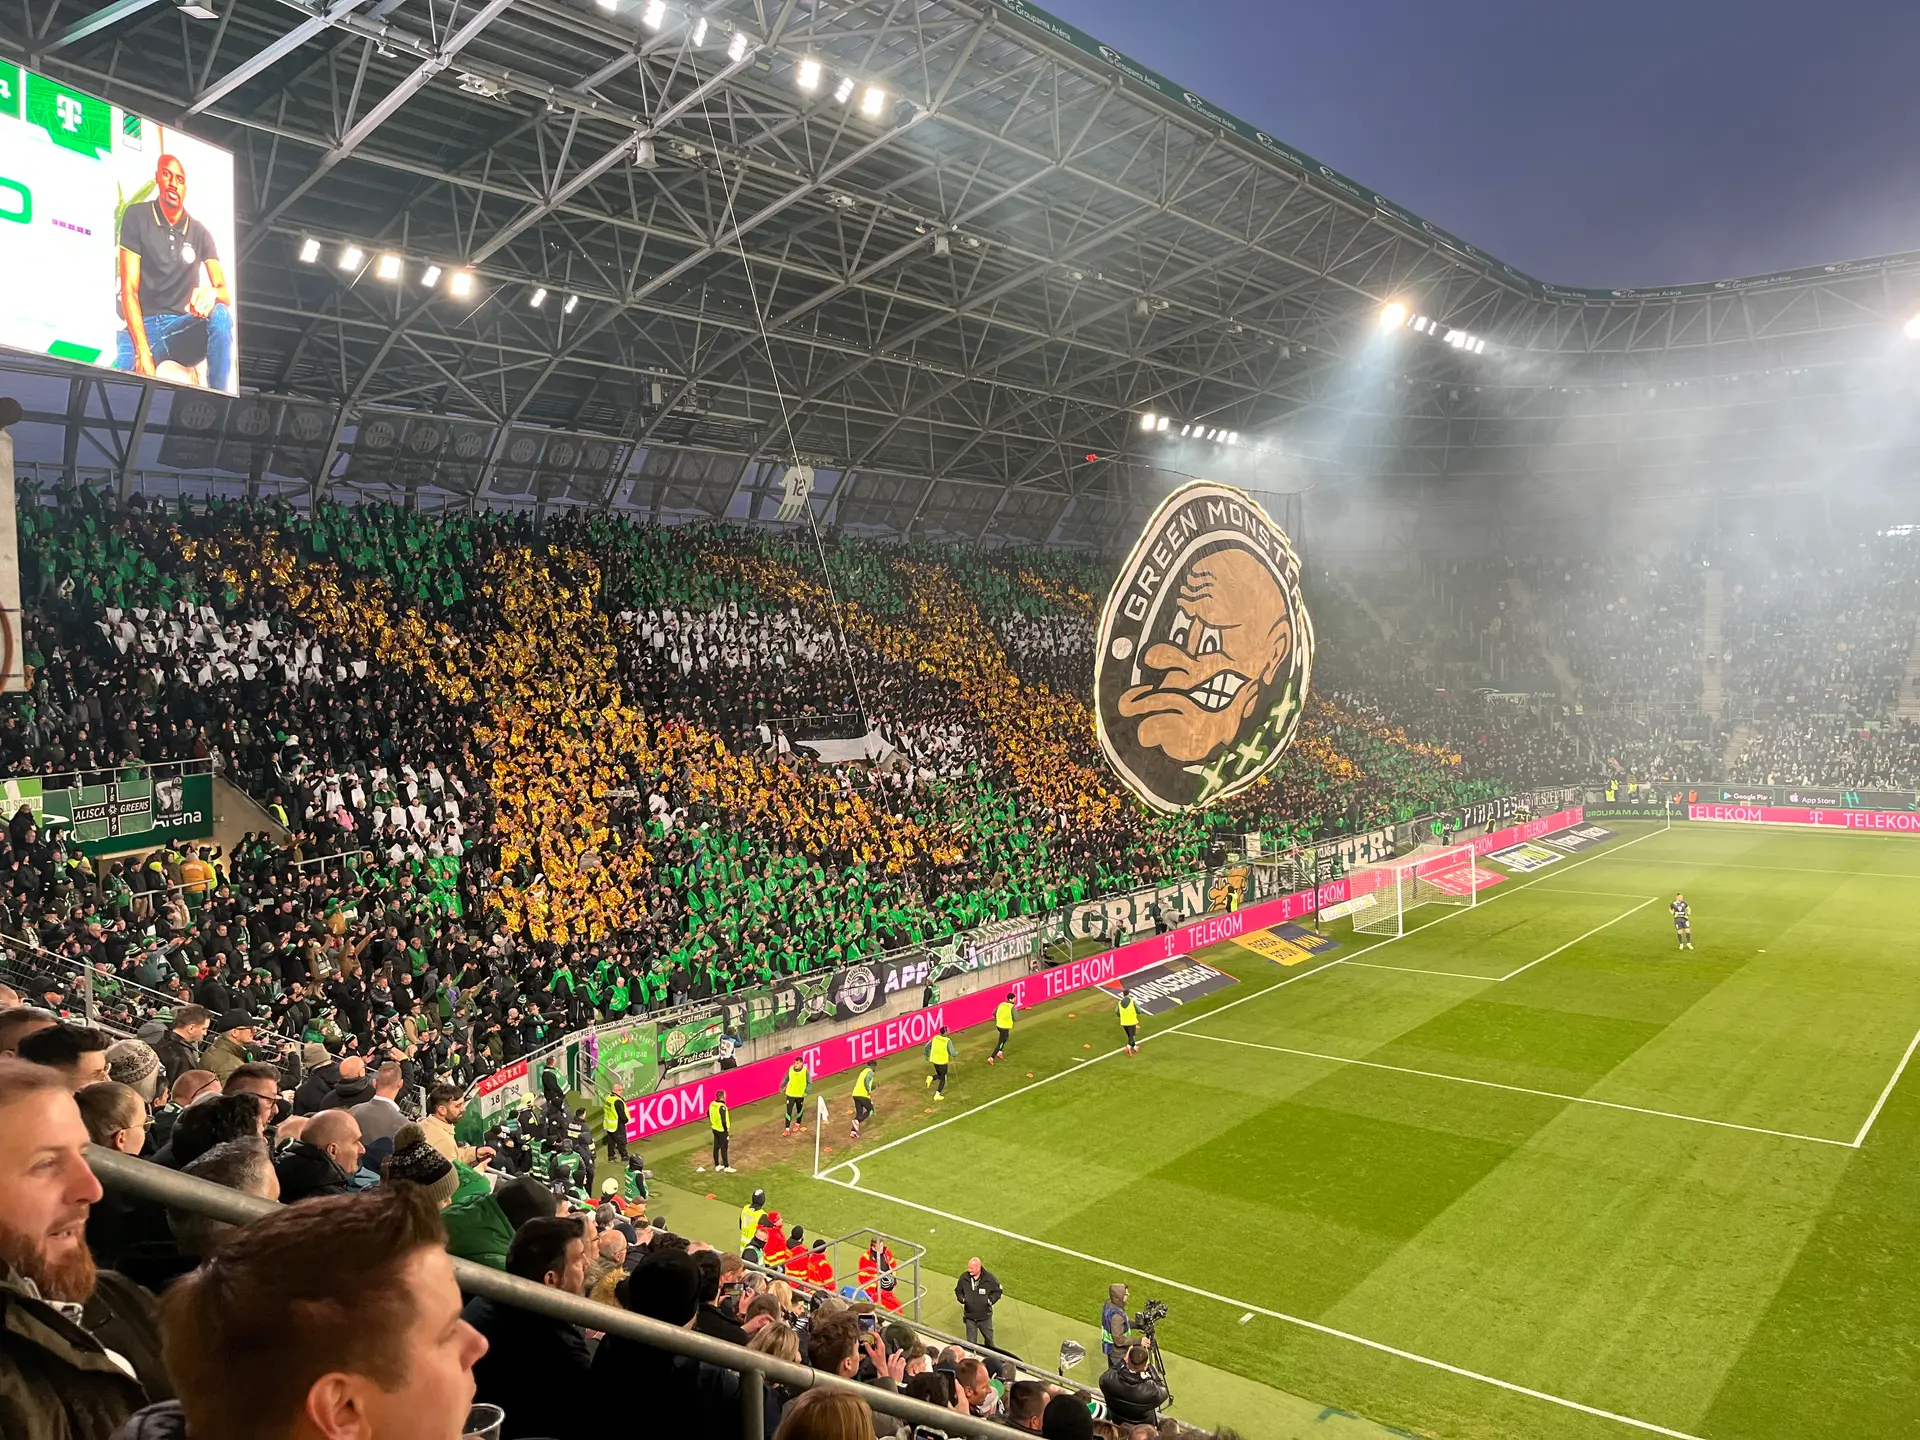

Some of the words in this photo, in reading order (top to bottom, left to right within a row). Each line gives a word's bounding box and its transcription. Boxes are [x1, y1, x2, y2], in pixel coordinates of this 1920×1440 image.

[1015, 4, 1050, 30] Groupama
[1114, 58, 1143, 80] Groupama
[1732, 278, 1768, 289] Groupama
[1627, 291, 1660, 299] Groupama
[792, 477, 806, 497] 12
[1124, 508, 1198, 621] GREEN
[1733, 792, 1757, 802] Google
[1801, 796, 1816, 805] App
[1817, 797, 1836, 805] Store
[75, 807, 106, 821] ALISCA
[120, 801, 149, 814] GREENS
[1586, 809, 1640, 818] GROUPAMA
[1642, 807, 1683, 817] ARÉNA
[1689, 805, 1763, 822] TELEKOM
[1069, 879, 1206, 941] GREEN
[846, 1006, 944, 1066] TELEKOM
[1043, 953, 1115, 997] TELEKOM
[1187, 912, 1243, 949] TELEKOM
[1301, 882, 1345, 912] TELEKOM
[1524, 819, 1549, 838] TELEKOM
[982, 936, 1033, 968] GREENS
